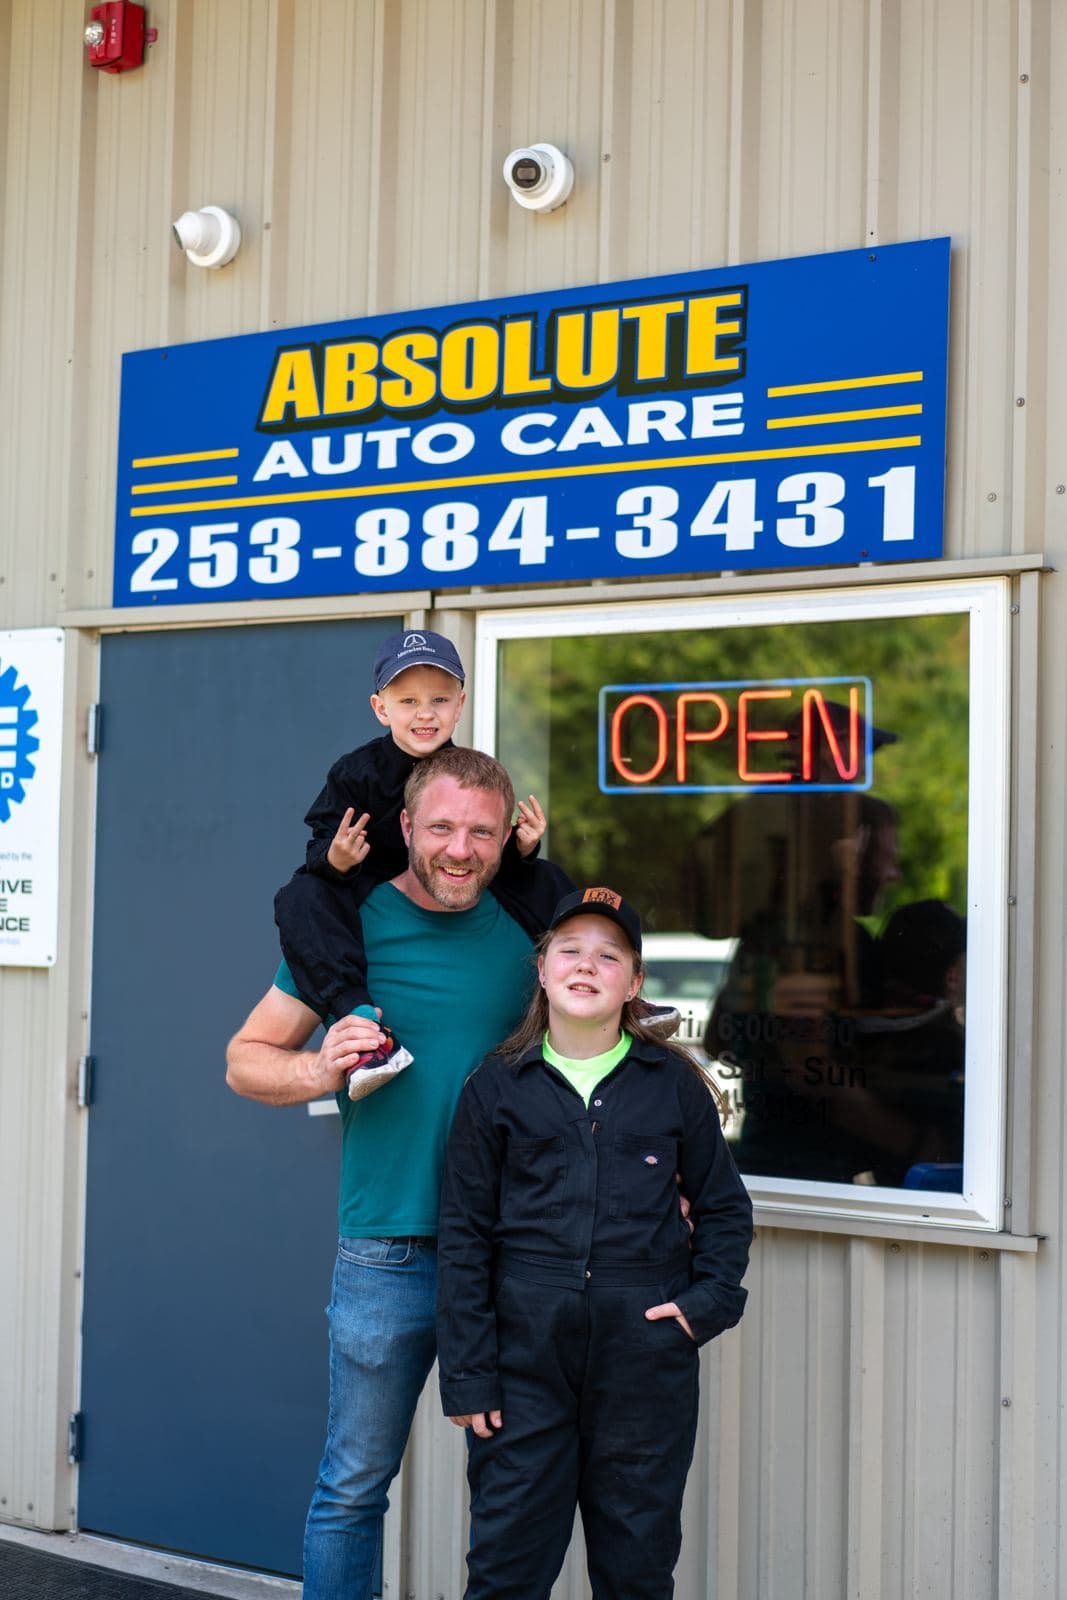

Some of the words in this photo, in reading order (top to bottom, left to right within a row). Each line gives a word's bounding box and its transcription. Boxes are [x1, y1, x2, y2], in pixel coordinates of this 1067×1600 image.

[262, 292, 742, 423] ABSOLUTE
[253, 422, 475, 482] AUTO
[501, 392, 745, 456] CARE
[130, 465, 916, 593] 253-884-3431
[611, 687, 858, 783] OPEN
[804, 1056, 867, 1088] Sun
